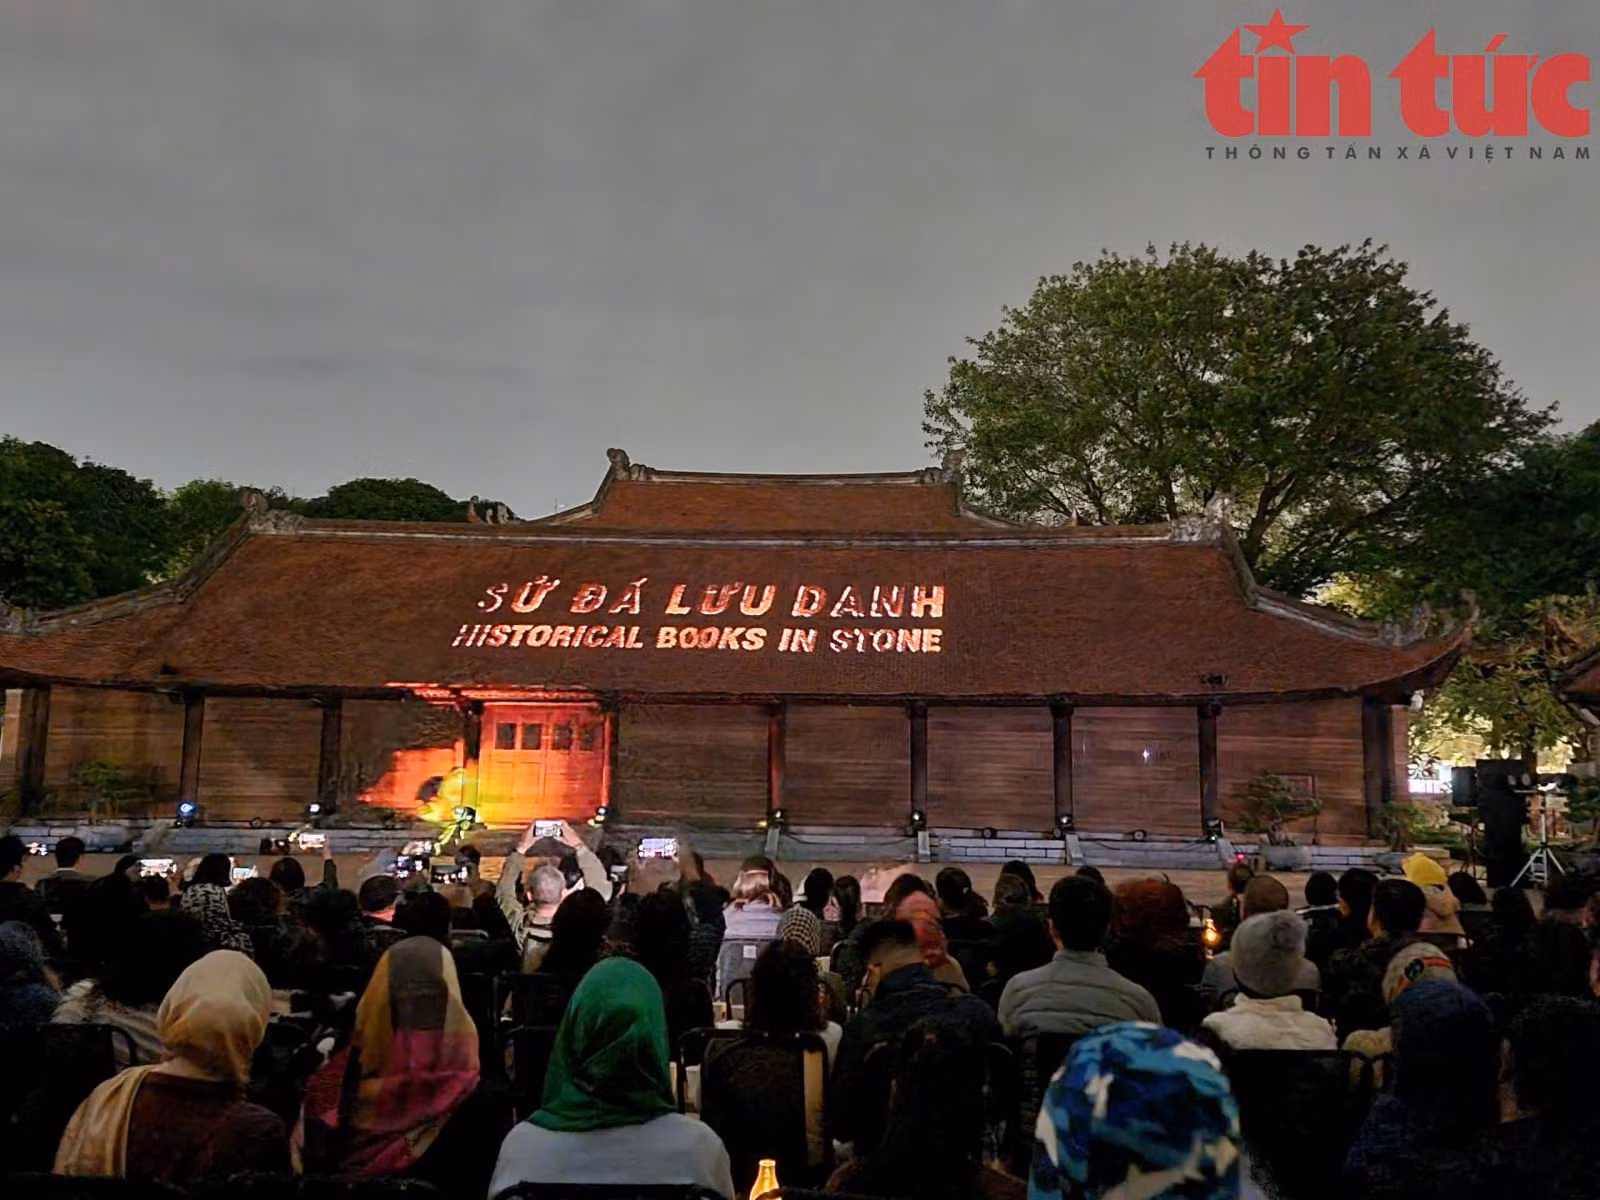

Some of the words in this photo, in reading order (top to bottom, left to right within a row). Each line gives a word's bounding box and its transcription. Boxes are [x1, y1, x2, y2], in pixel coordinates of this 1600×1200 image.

[792, 584, 945, 618] DANH
[451, 624, 644, 648] HISTORICAL
[656, 626, 768, 650] BOOKS
[778, 628, 817, 652] IN
[830, 628, 943, 652] STONE
